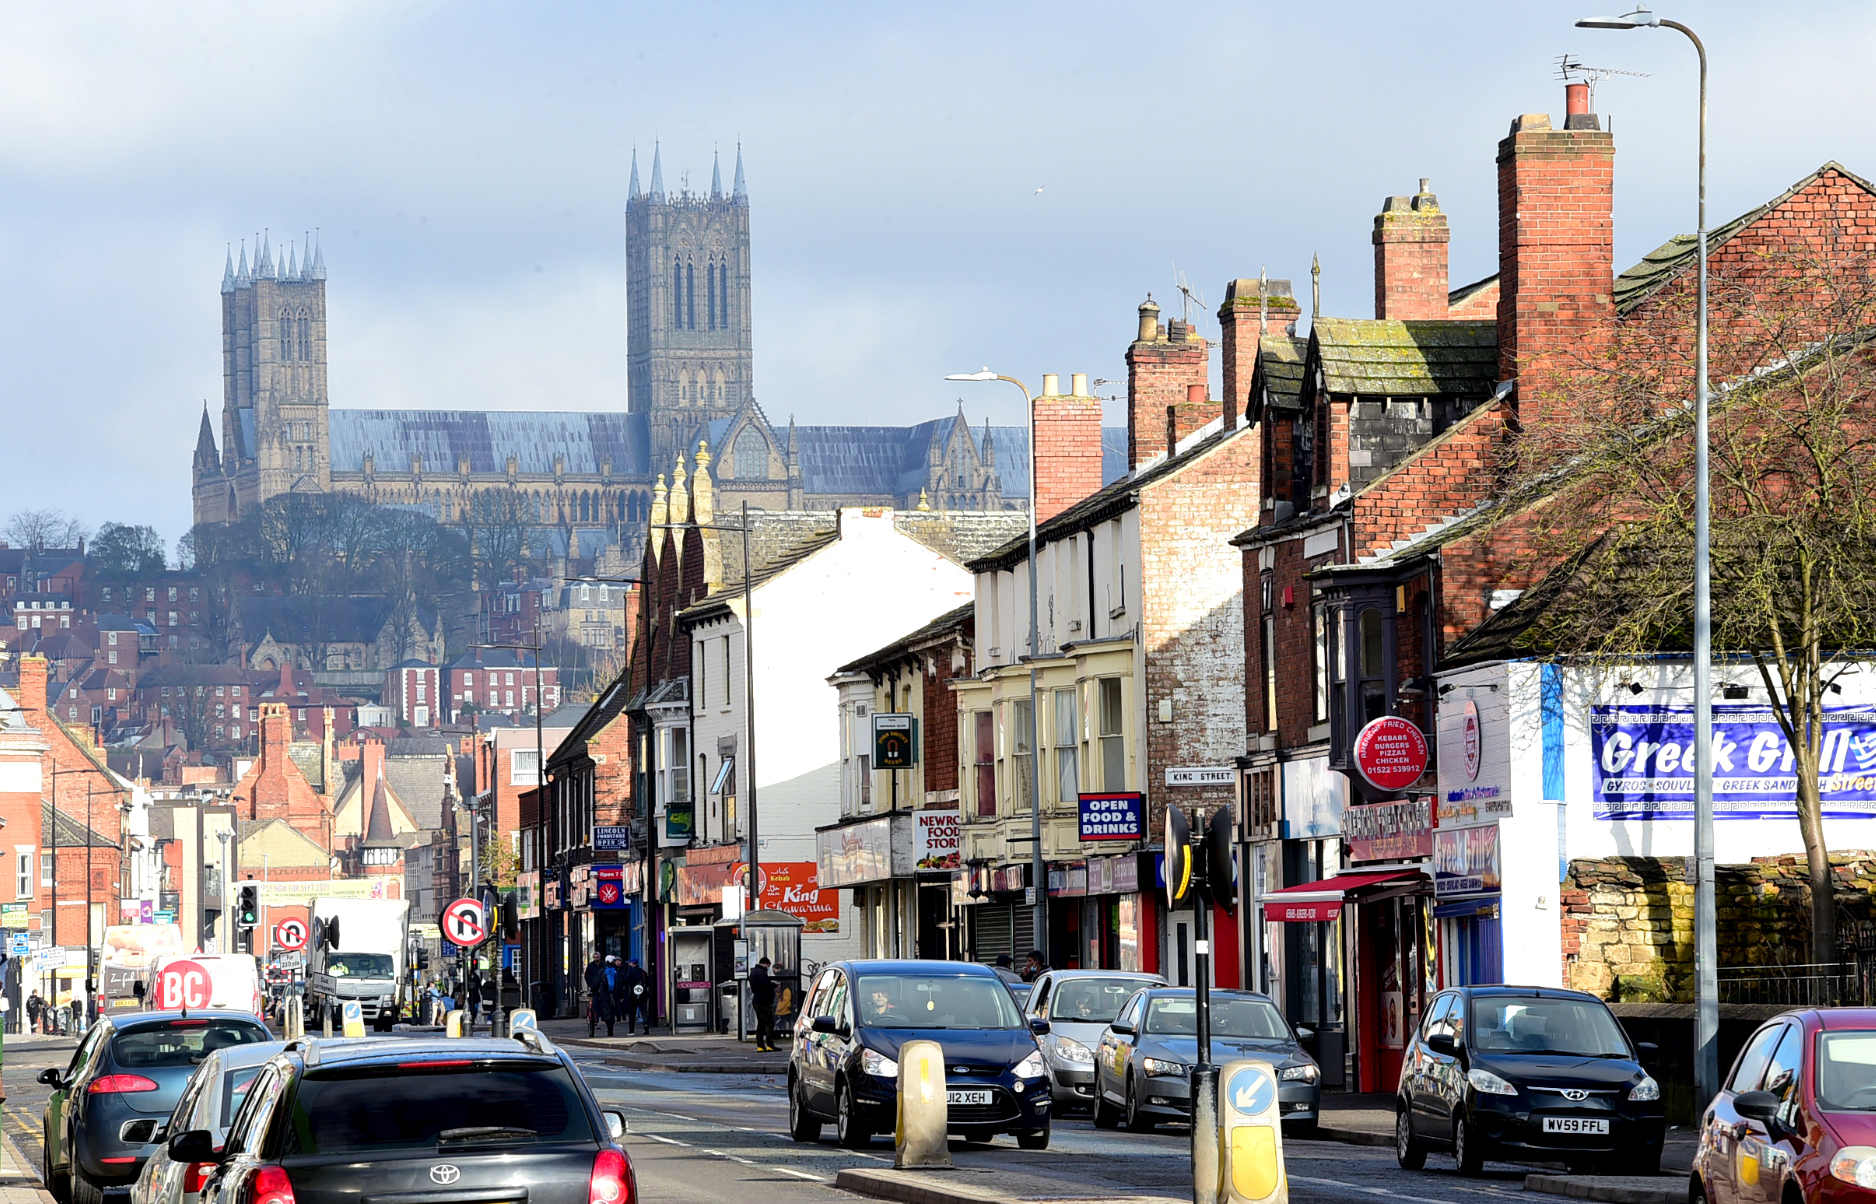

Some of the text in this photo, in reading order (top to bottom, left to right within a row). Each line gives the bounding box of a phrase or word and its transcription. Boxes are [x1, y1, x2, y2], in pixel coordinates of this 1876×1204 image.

[1361, 721, 1425, 758] AMERICAN FRIED CHICKEN
[1367, 765, 1420, 774] 01522 539912
[1607, 780, 1647, 791] GYROS
[1722, 780, 1760, 791] GREEK
[1763, 780, 1827, 791] SANDH
[1089, 800, 1129, 811] OPEN
[1082, 811, 1137, 822] FOOD &
[1082, 823, 1138, 834] DRINKS
[926, 838, 960, 849] STOR
[1435, 831, 1463, 874] Greek
[1464, 828, 1485, 871] Grill
[301, 883, 314, 892] SEPT
[315, 883, 330, 892] 2021
[782, 886, 819, 904] King
[764, 901, 833, 913] Shawarma
[320, 976, 329, 984] Dual
[163, 971, 204, 1008] BC
[965, 1092, 985, 1103] XEH
[1548, 1119, 1604, 1132] WV59 FFL
